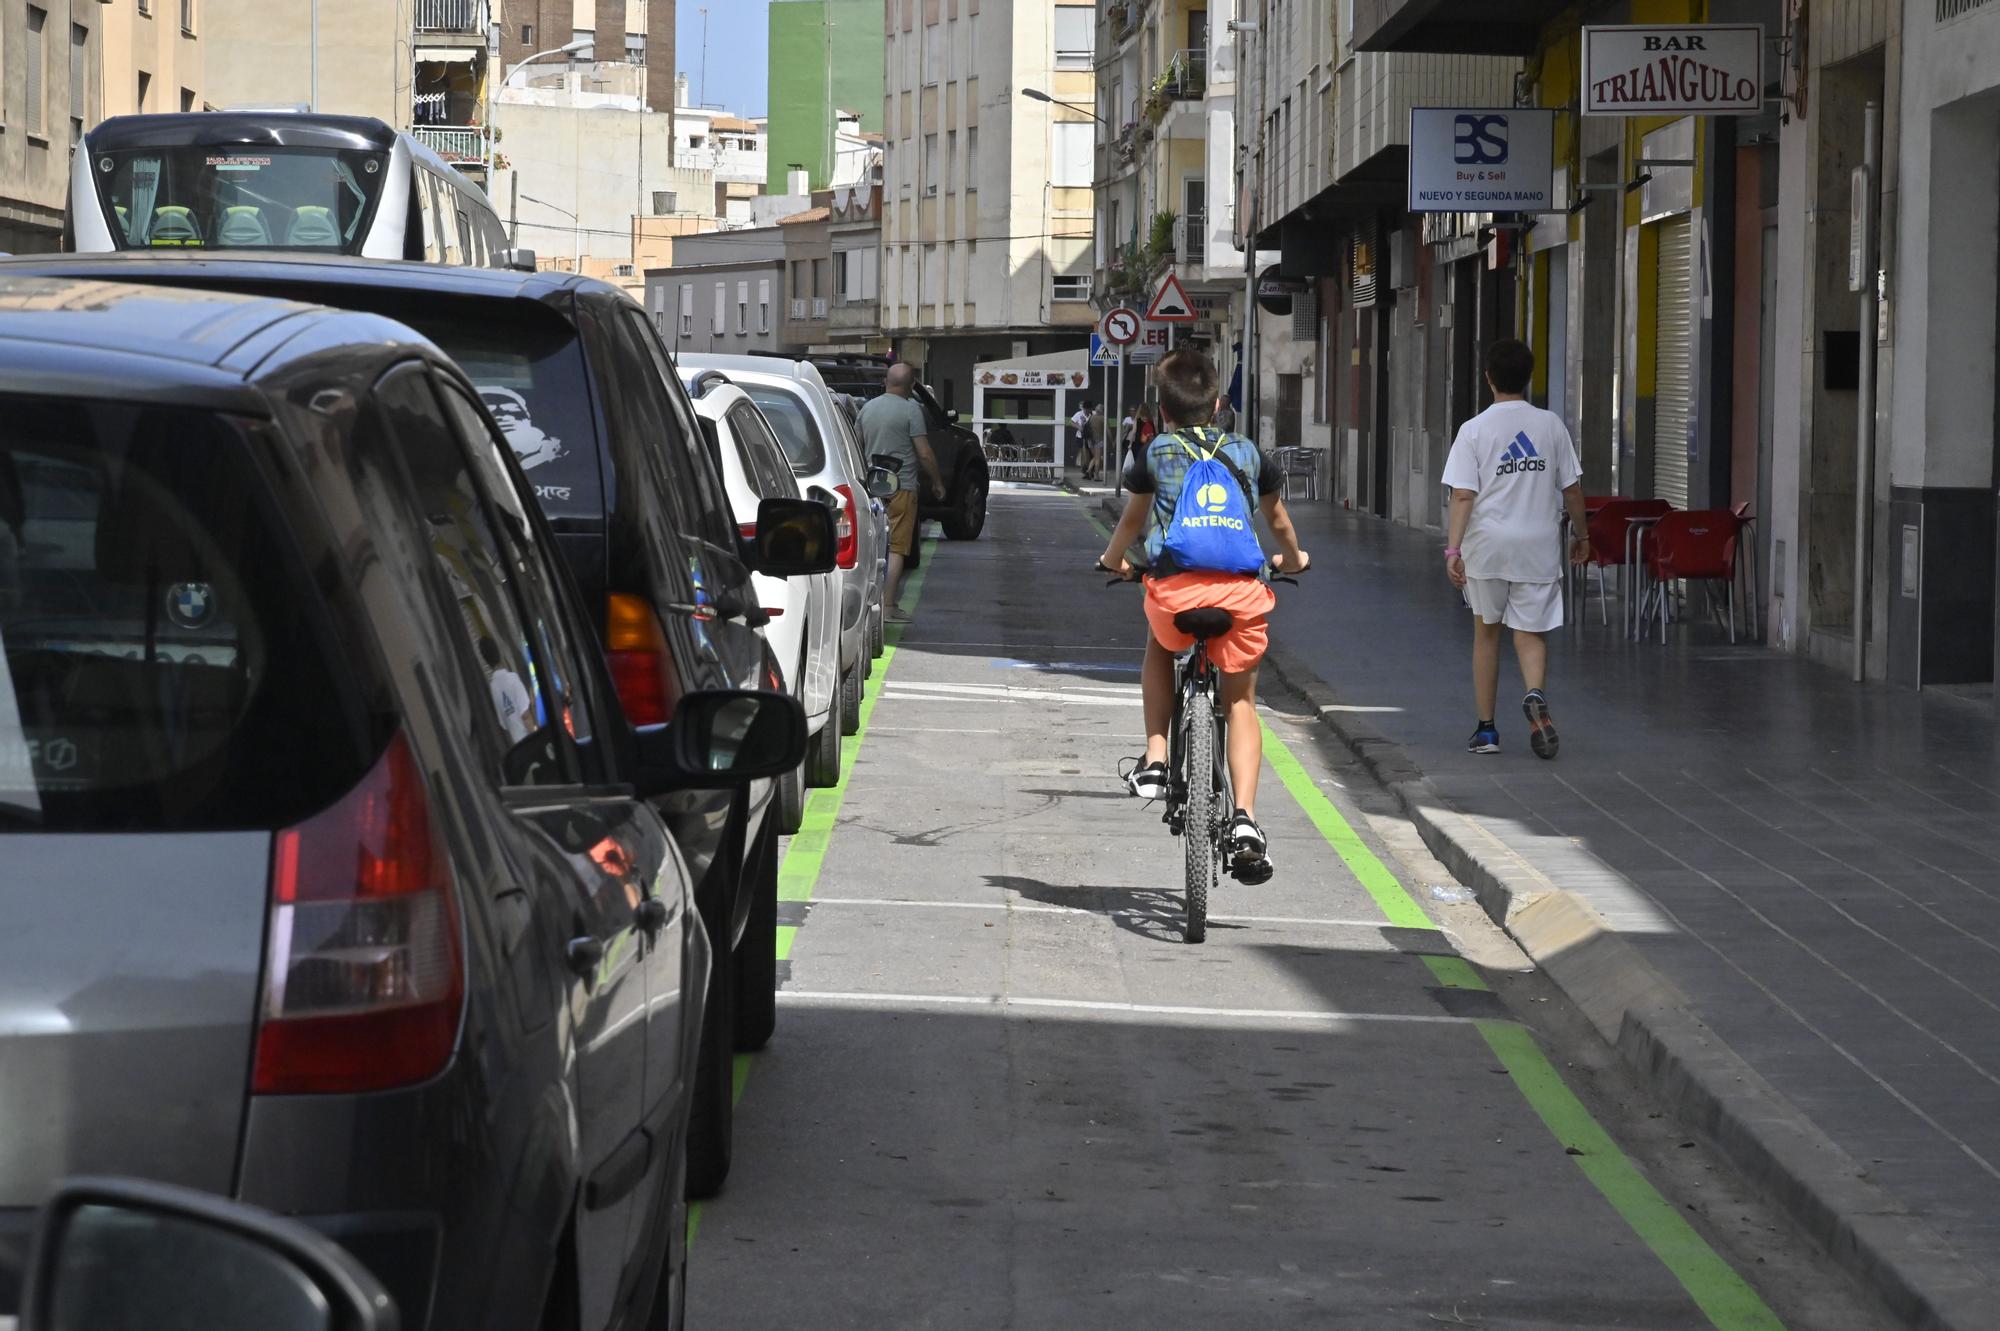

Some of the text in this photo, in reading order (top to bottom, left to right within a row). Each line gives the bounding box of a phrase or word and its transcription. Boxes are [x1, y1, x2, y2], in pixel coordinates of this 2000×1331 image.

[1643, 35, 1707, 51] BAR
[1592, 54, 1756, 103] TRIANGULO
[1454, 114, 1509, 164] BS
[1456, 171, 1506, 182] Buy & Sell
[1419, 191, 1544, 201] NUEVO Y SEGUNDA MANO
[1495, 457, 1546, 476] adidas
[1181, 515, 1244, 531] ARTENGO
